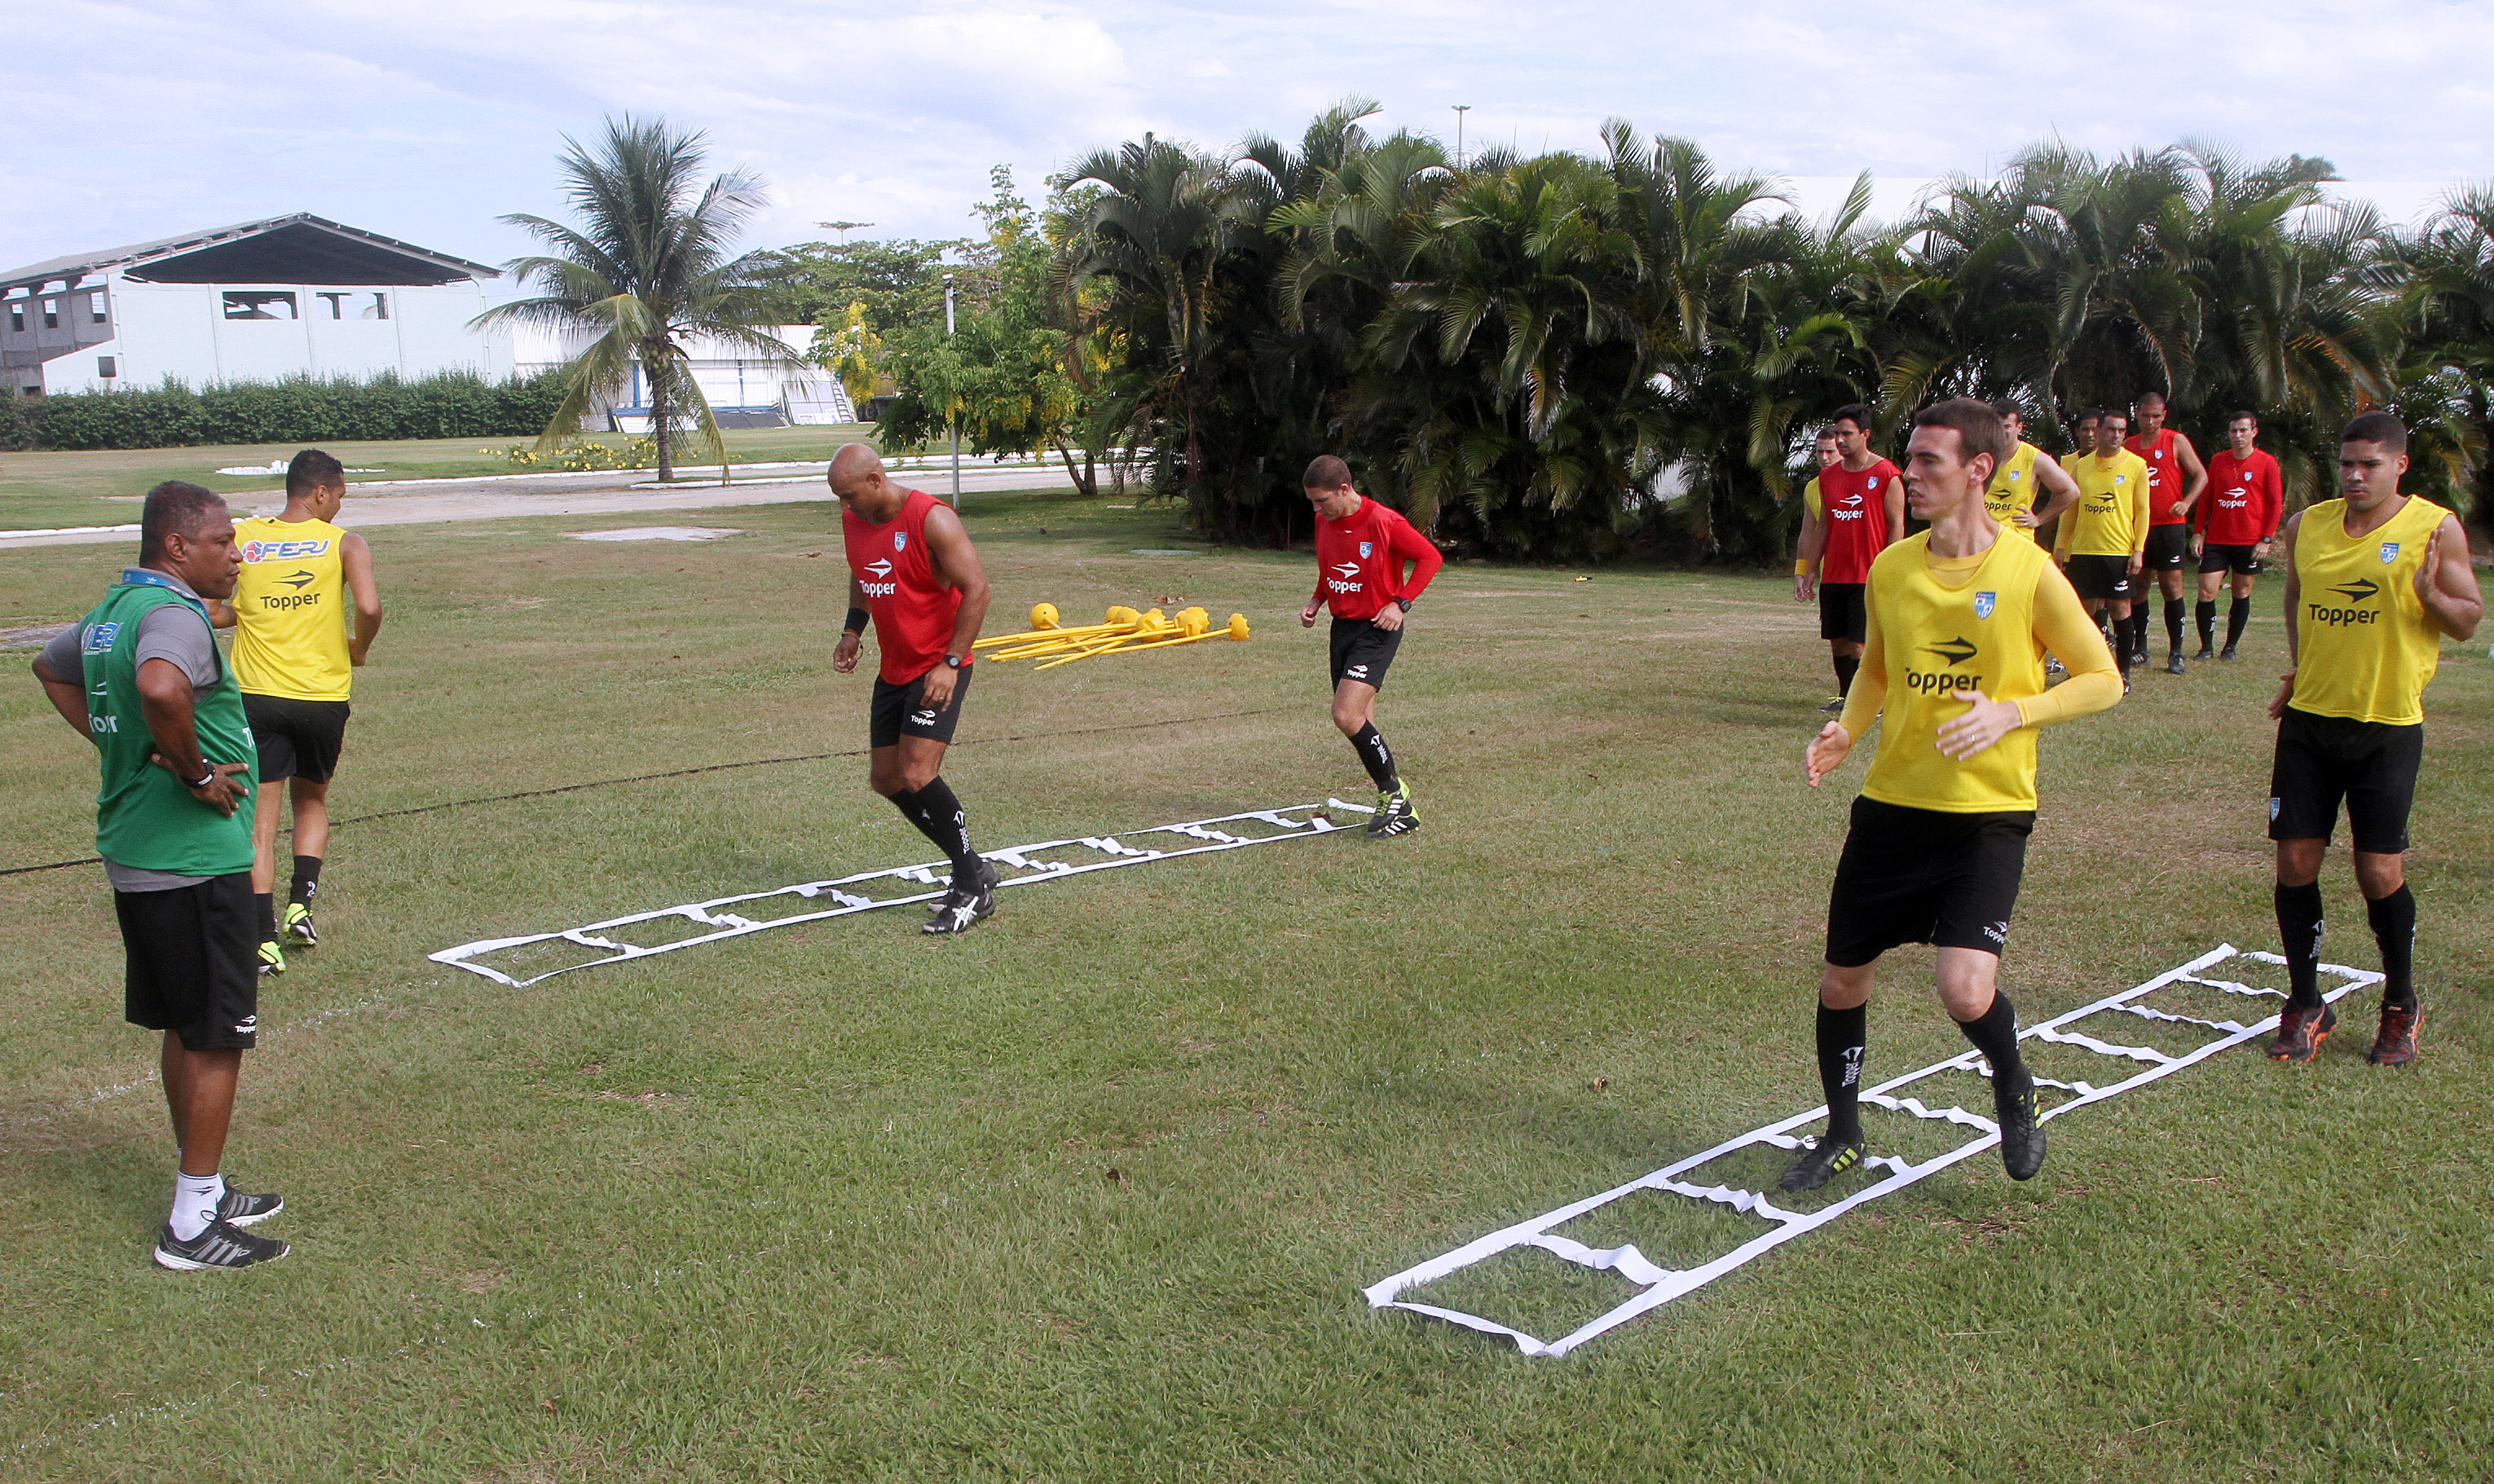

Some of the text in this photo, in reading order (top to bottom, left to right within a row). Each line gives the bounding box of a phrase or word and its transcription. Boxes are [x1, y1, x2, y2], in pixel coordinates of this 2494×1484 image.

[1985, 502, 2012, 512] opper
[2085, 504, 2116, 514] Topper
[2218, 500, 2247, 509] Topper
[1831, 509, 1864, 521] Topper
[261, 539, 331, 558] FERJ
[859, 579, 896, 598] Topper
[260, 592, 321, 611] Topper
[2308, 604, 2381, 627] Topper
[911, 715, 935, 726] Topper
